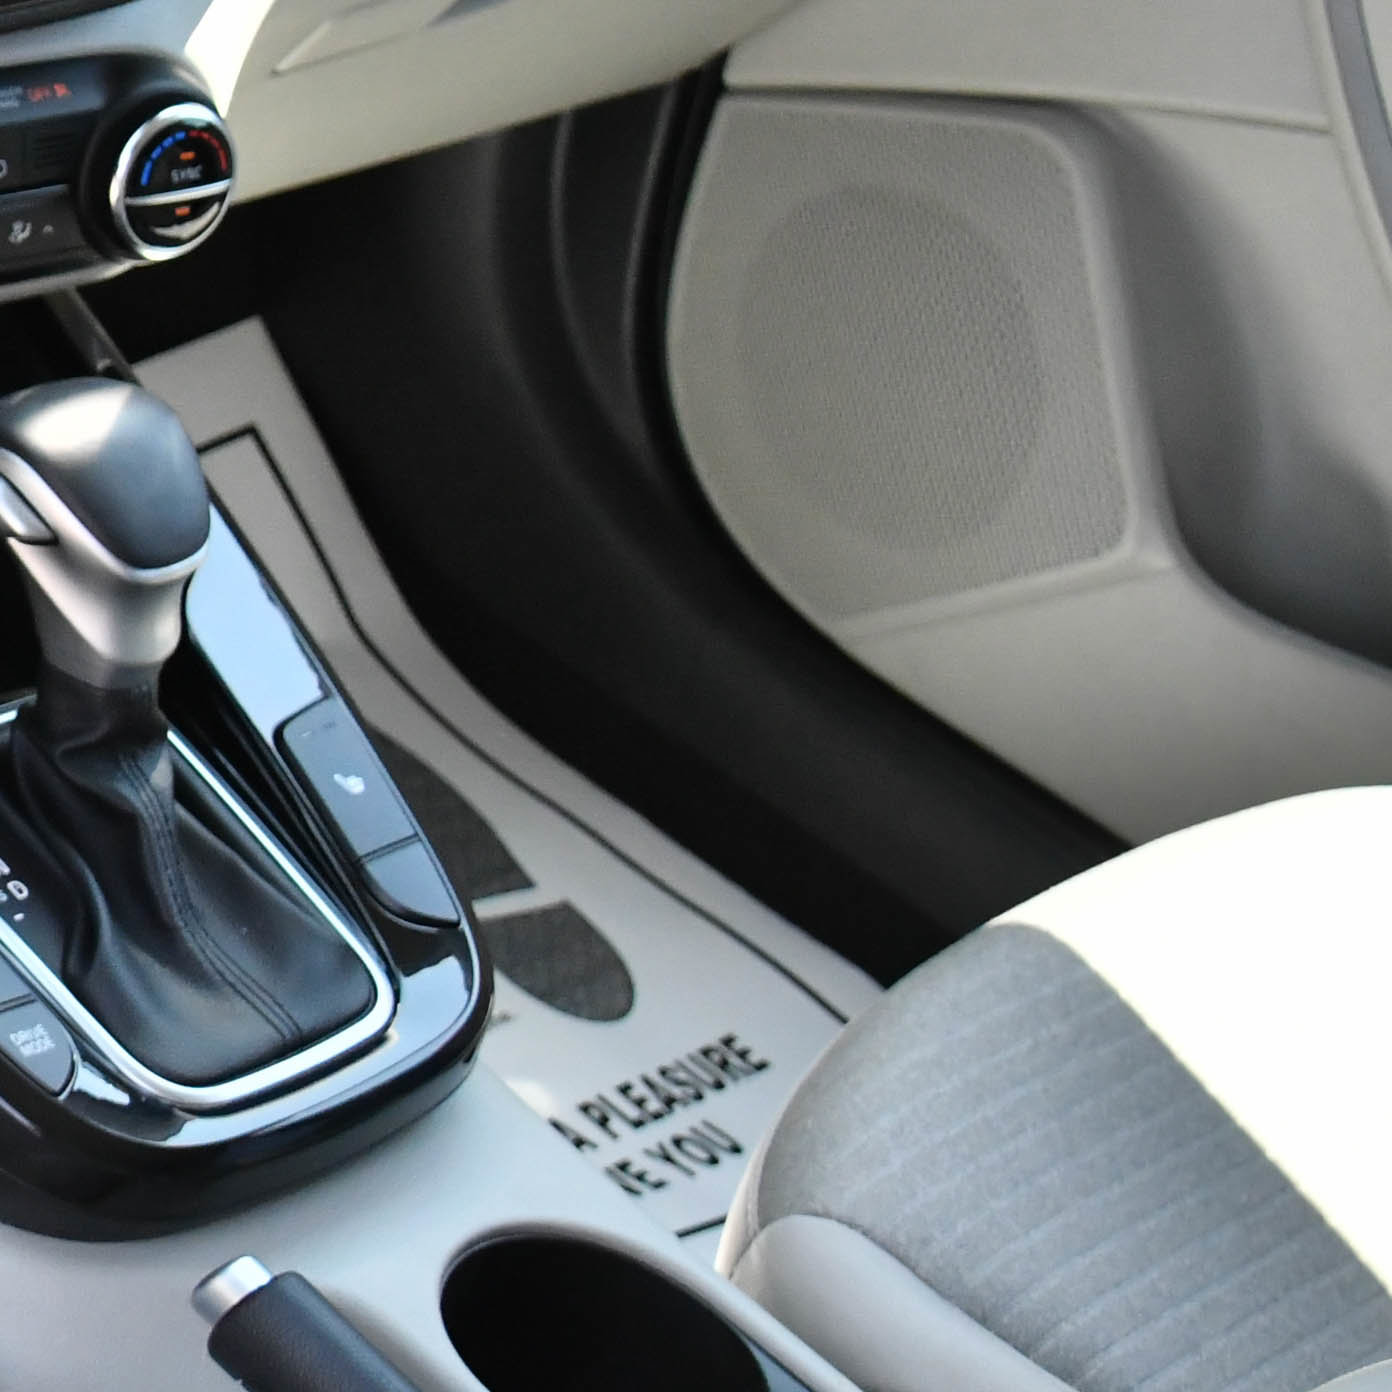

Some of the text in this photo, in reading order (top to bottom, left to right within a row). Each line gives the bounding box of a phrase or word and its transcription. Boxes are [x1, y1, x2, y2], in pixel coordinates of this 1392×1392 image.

[7, 880, 29, 901] D
[576, 1032, 772, 1140] PLEASURE
[643, 1119, 744, 1176] YOU
